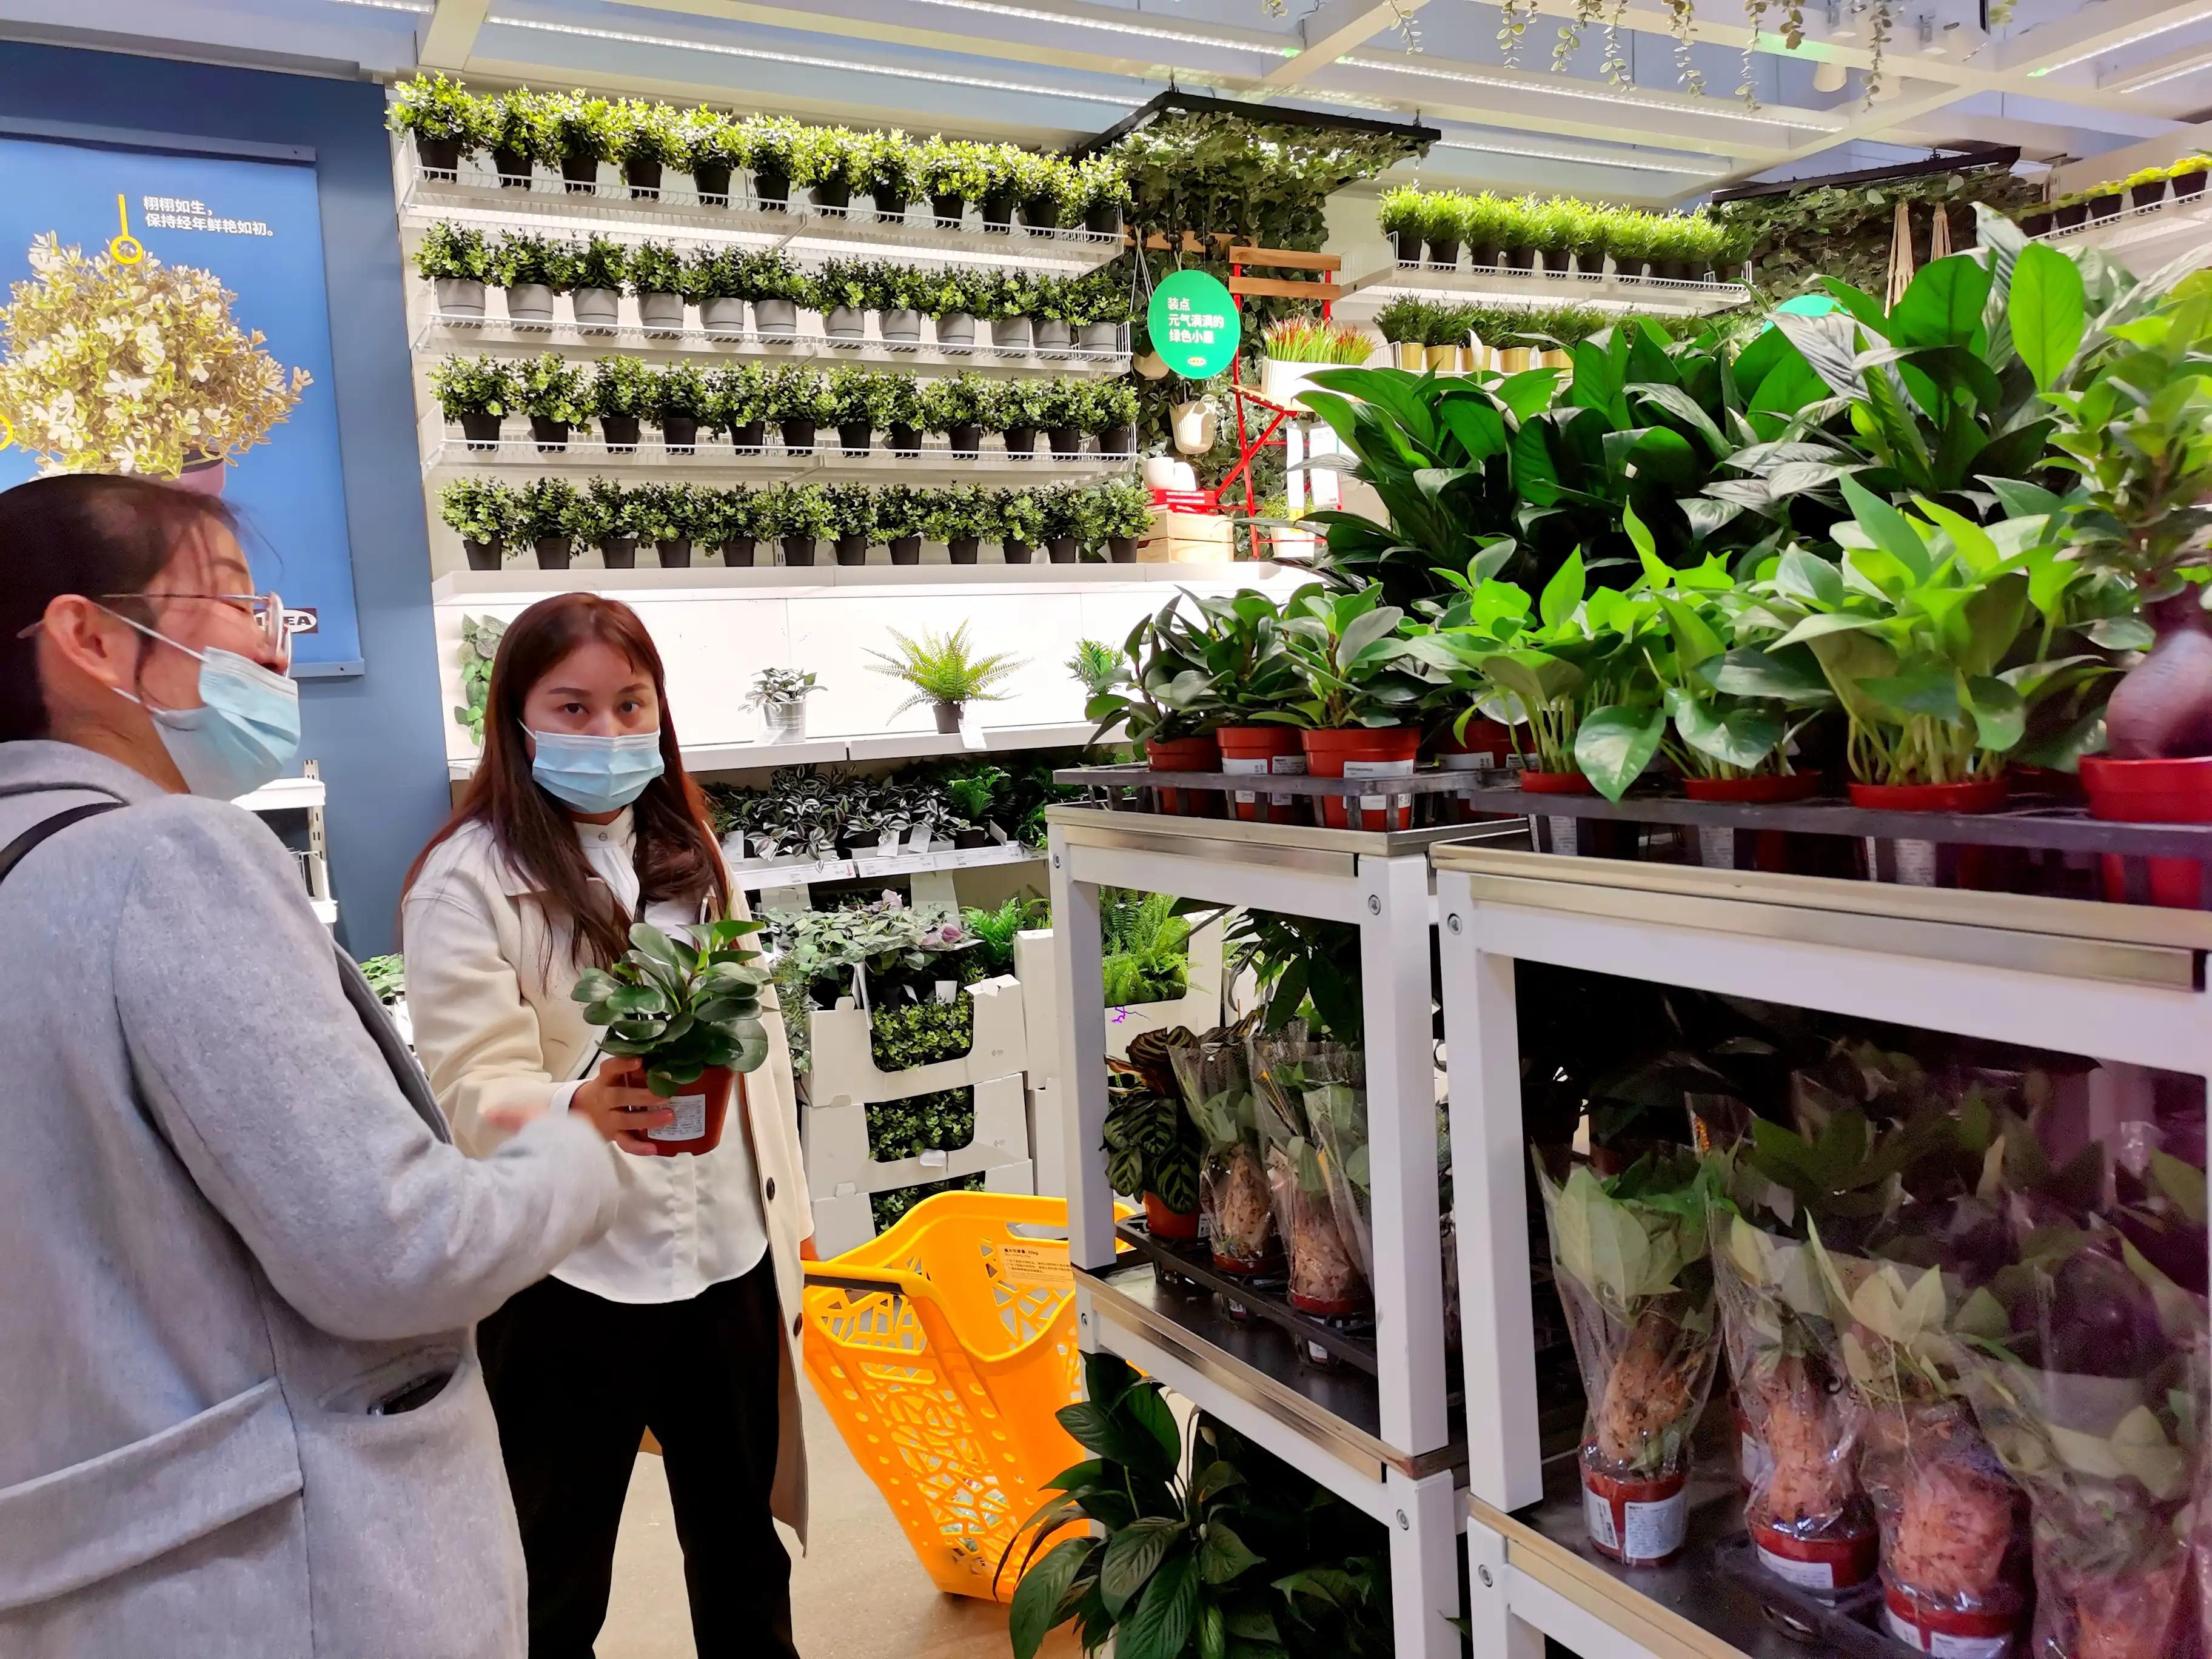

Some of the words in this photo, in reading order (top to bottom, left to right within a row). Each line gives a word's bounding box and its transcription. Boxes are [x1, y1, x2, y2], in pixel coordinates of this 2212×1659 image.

[143, 196, 213, 216] 栩栩如生，
[145, 213, 273, 236] 保持经年鲜艳如初。
[1167, 297, 1190, 311] 装点
